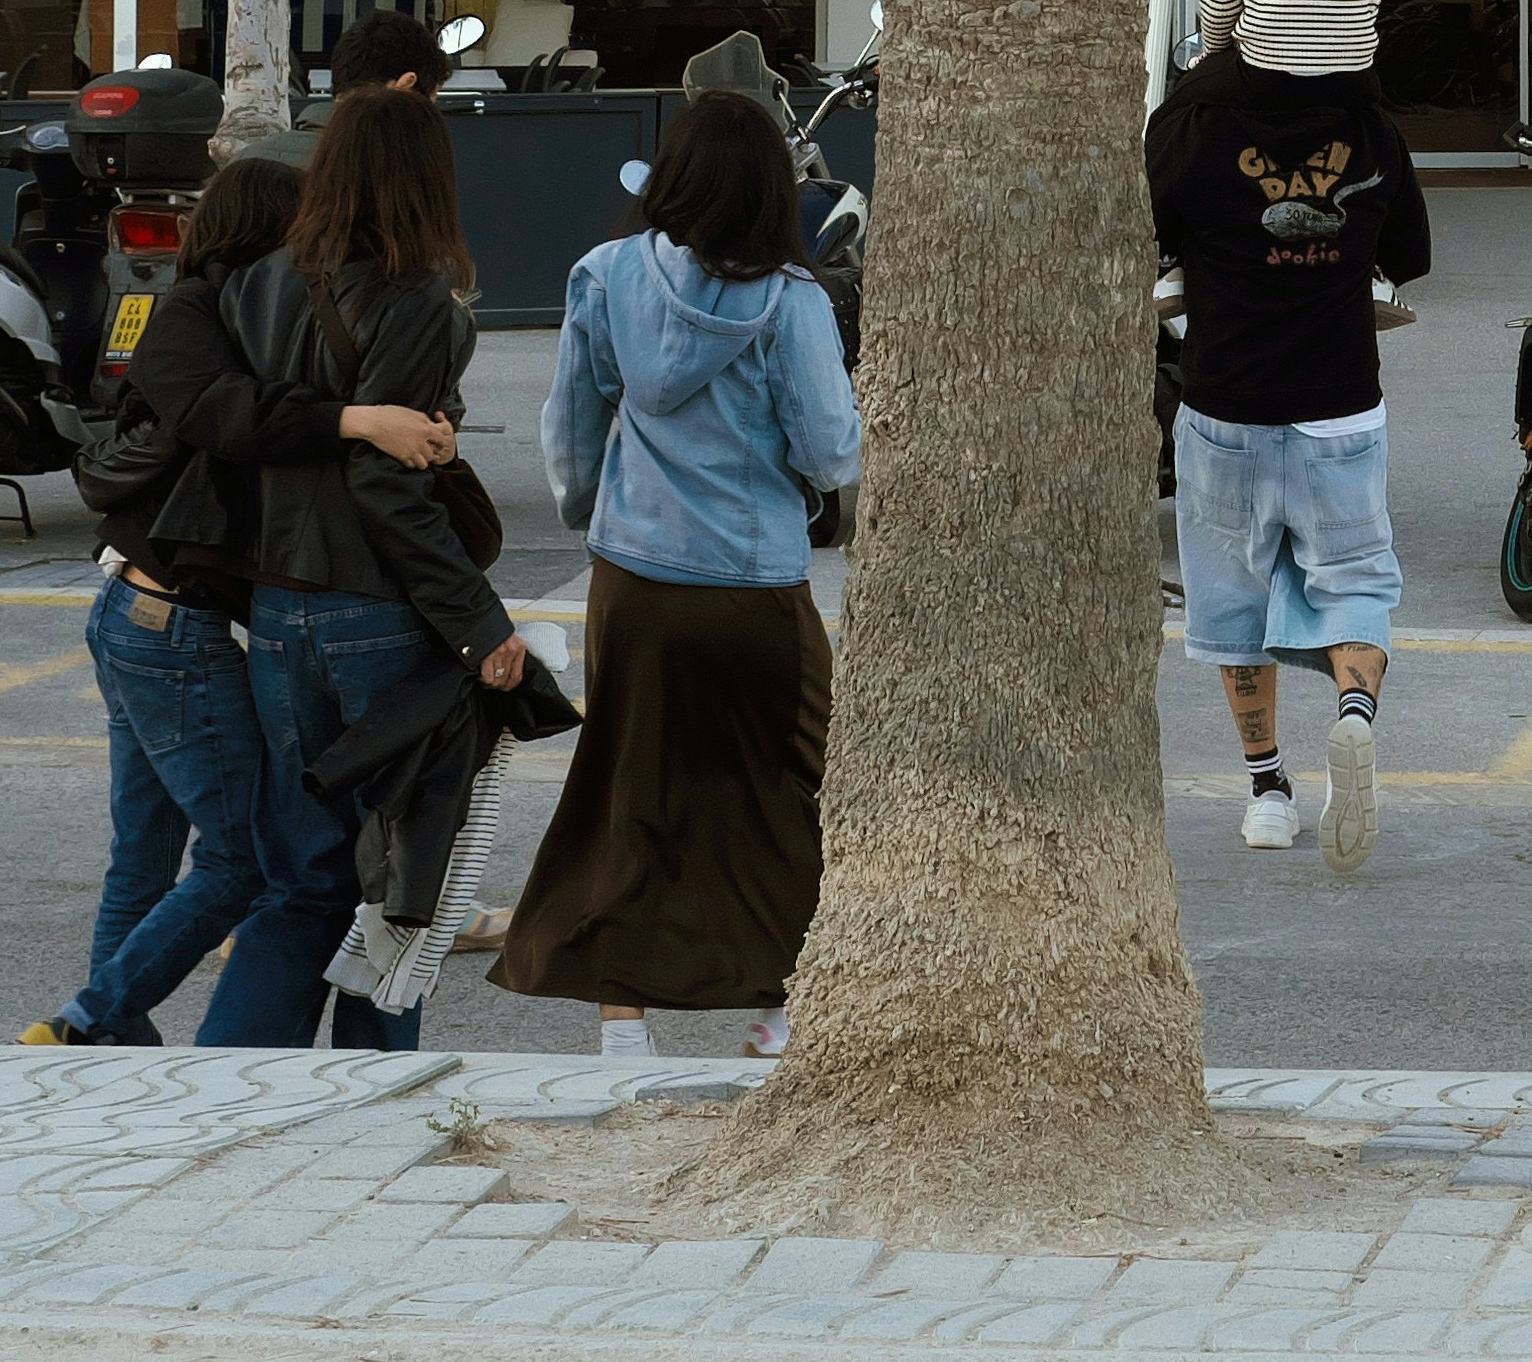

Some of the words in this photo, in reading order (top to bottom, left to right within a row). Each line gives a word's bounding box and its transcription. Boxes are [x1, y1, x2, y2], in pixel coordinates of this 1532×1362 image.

[1238, 141, 1352, 178] GEN
[1259, 171, 1341, 202] DAY
[1267, 242, 1340, 266] dookie
